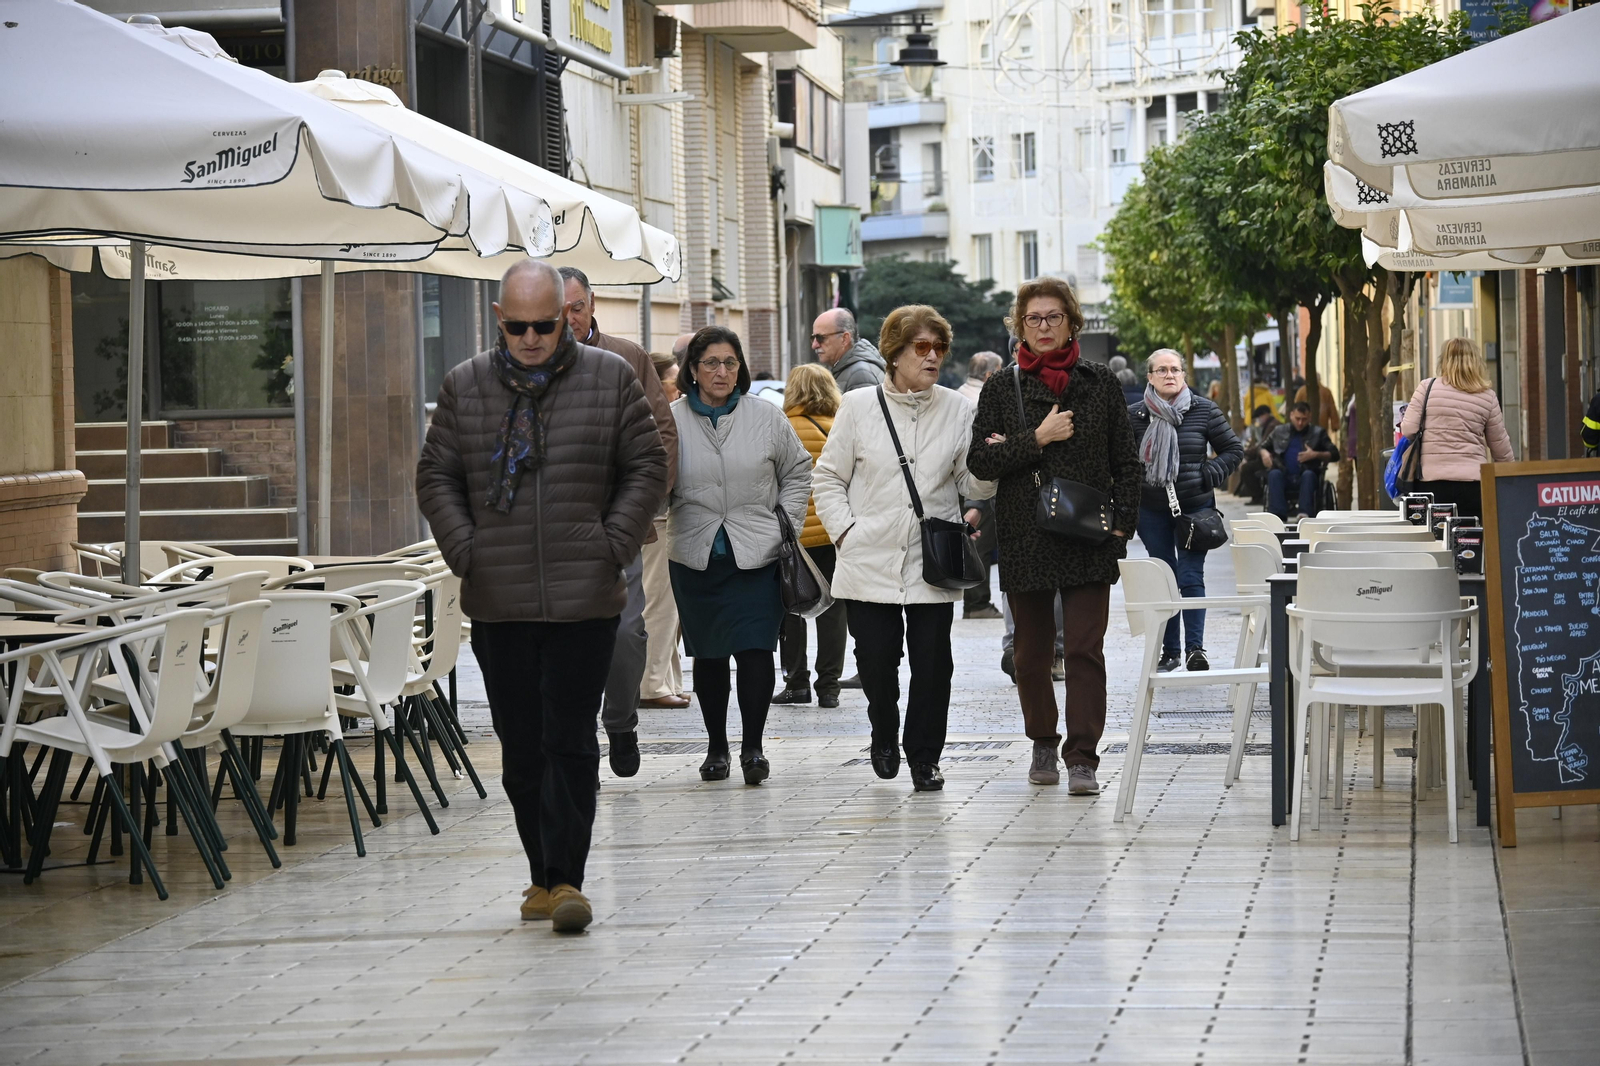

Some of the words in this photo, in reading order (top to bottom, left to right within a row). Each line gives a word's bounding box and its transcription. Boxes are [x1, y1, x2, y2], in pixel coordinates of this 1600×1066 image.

[180, 132, 278, 184] SanMiguel
[1557, 506, 1568, 516] El
[1569, 505, 1586, 518] café
[1588, 504, 1599, 515] de
[1540, 530, 1560, 538] SALTA
[1562, 523, 1588, 536] FORMOSA
[1520, 566, 1555, 574] CATAMARCA
[1582, 572, 1598, 580] SANTA
[1356, 584, 1393, 596] SanMiguel
[1522, 609, 1548, 619] MENDOZA
[1568, 622, 1588, 630] BUENOS
[1532, 707, 1550, 715] SANTA
[1559, 748, 1578, 758] TIERRA
[1568, 759, 1586, 769] FUEGO
